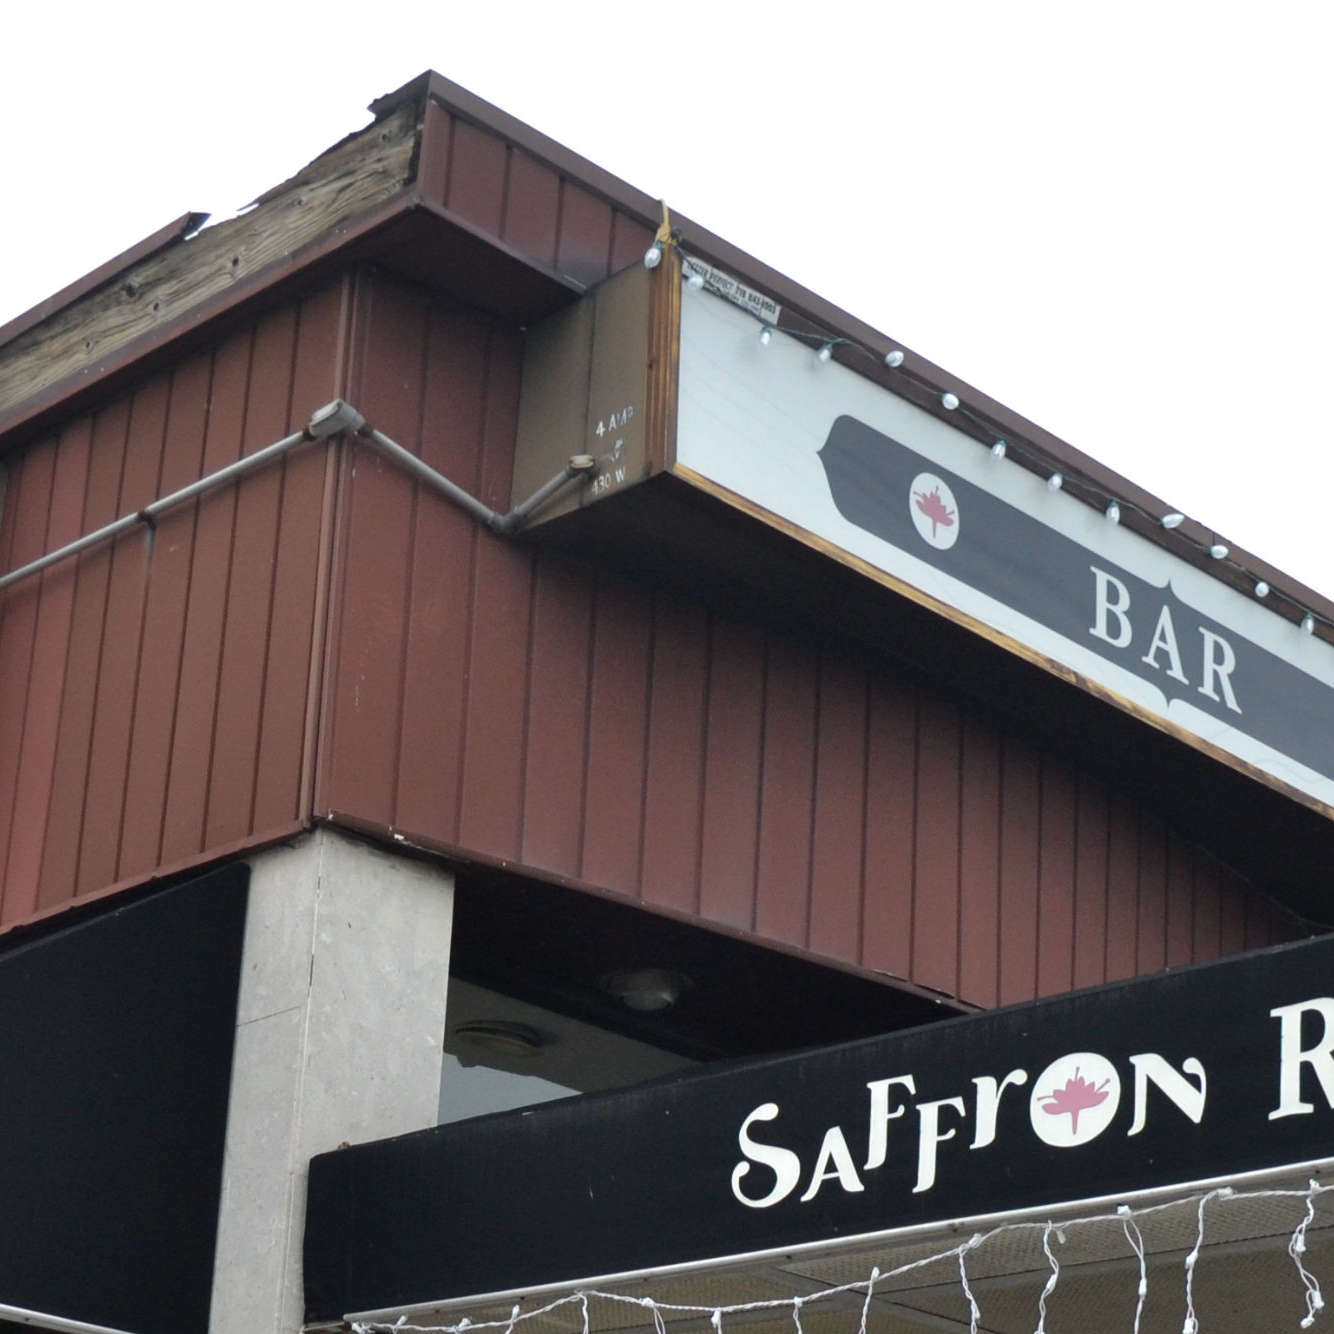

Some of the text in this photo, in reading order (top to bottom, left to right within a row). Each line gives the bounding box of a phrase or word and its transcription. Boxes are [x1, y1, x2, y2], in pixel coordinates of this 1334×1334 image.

[595, 420, 606, 437] 4
[591, 472, 611, 495] 430
[1088, 566, 1243, 715] BAR
